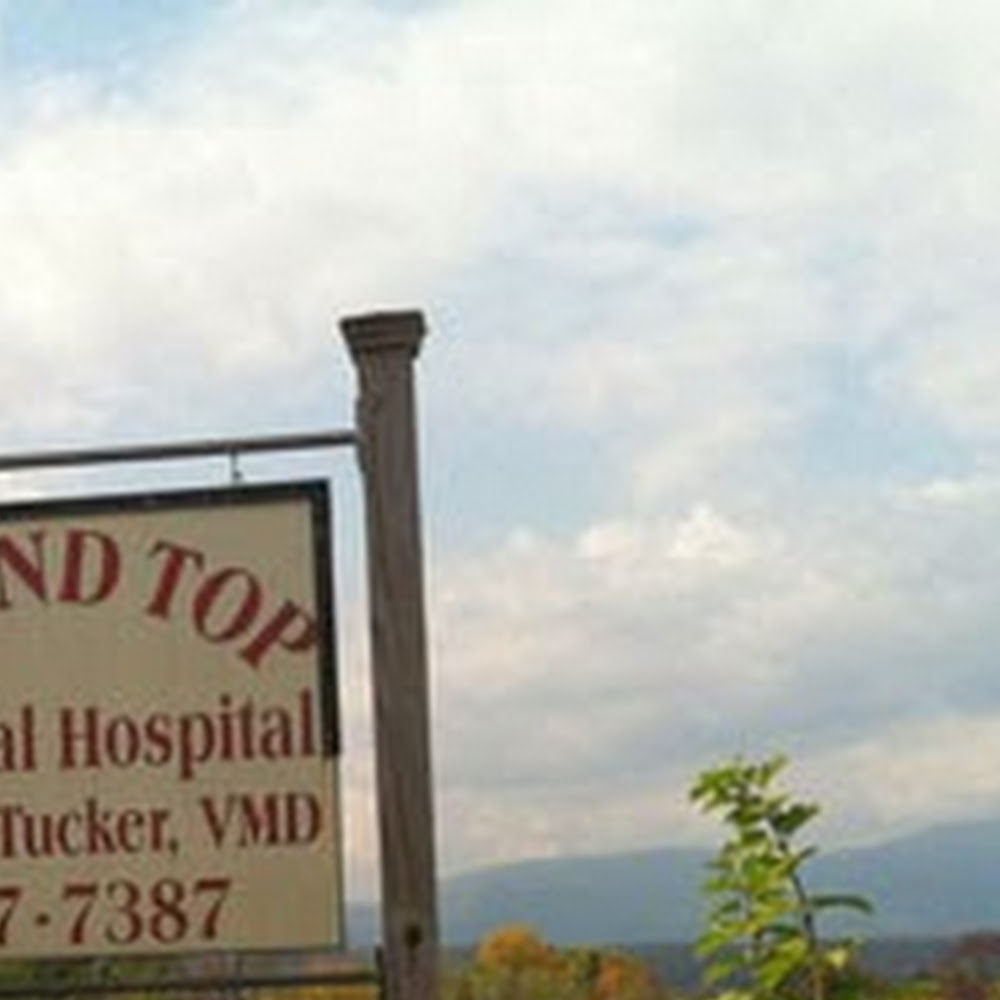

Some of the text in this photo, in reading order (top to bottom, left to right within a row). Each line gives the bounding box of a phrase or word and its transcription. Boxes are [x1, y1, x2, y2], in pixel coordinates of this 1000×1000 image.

[144, 539, 319, 671] TOP
[58, 689, 318, 780] Hospital
[199, 793, 322, 850] VMD
